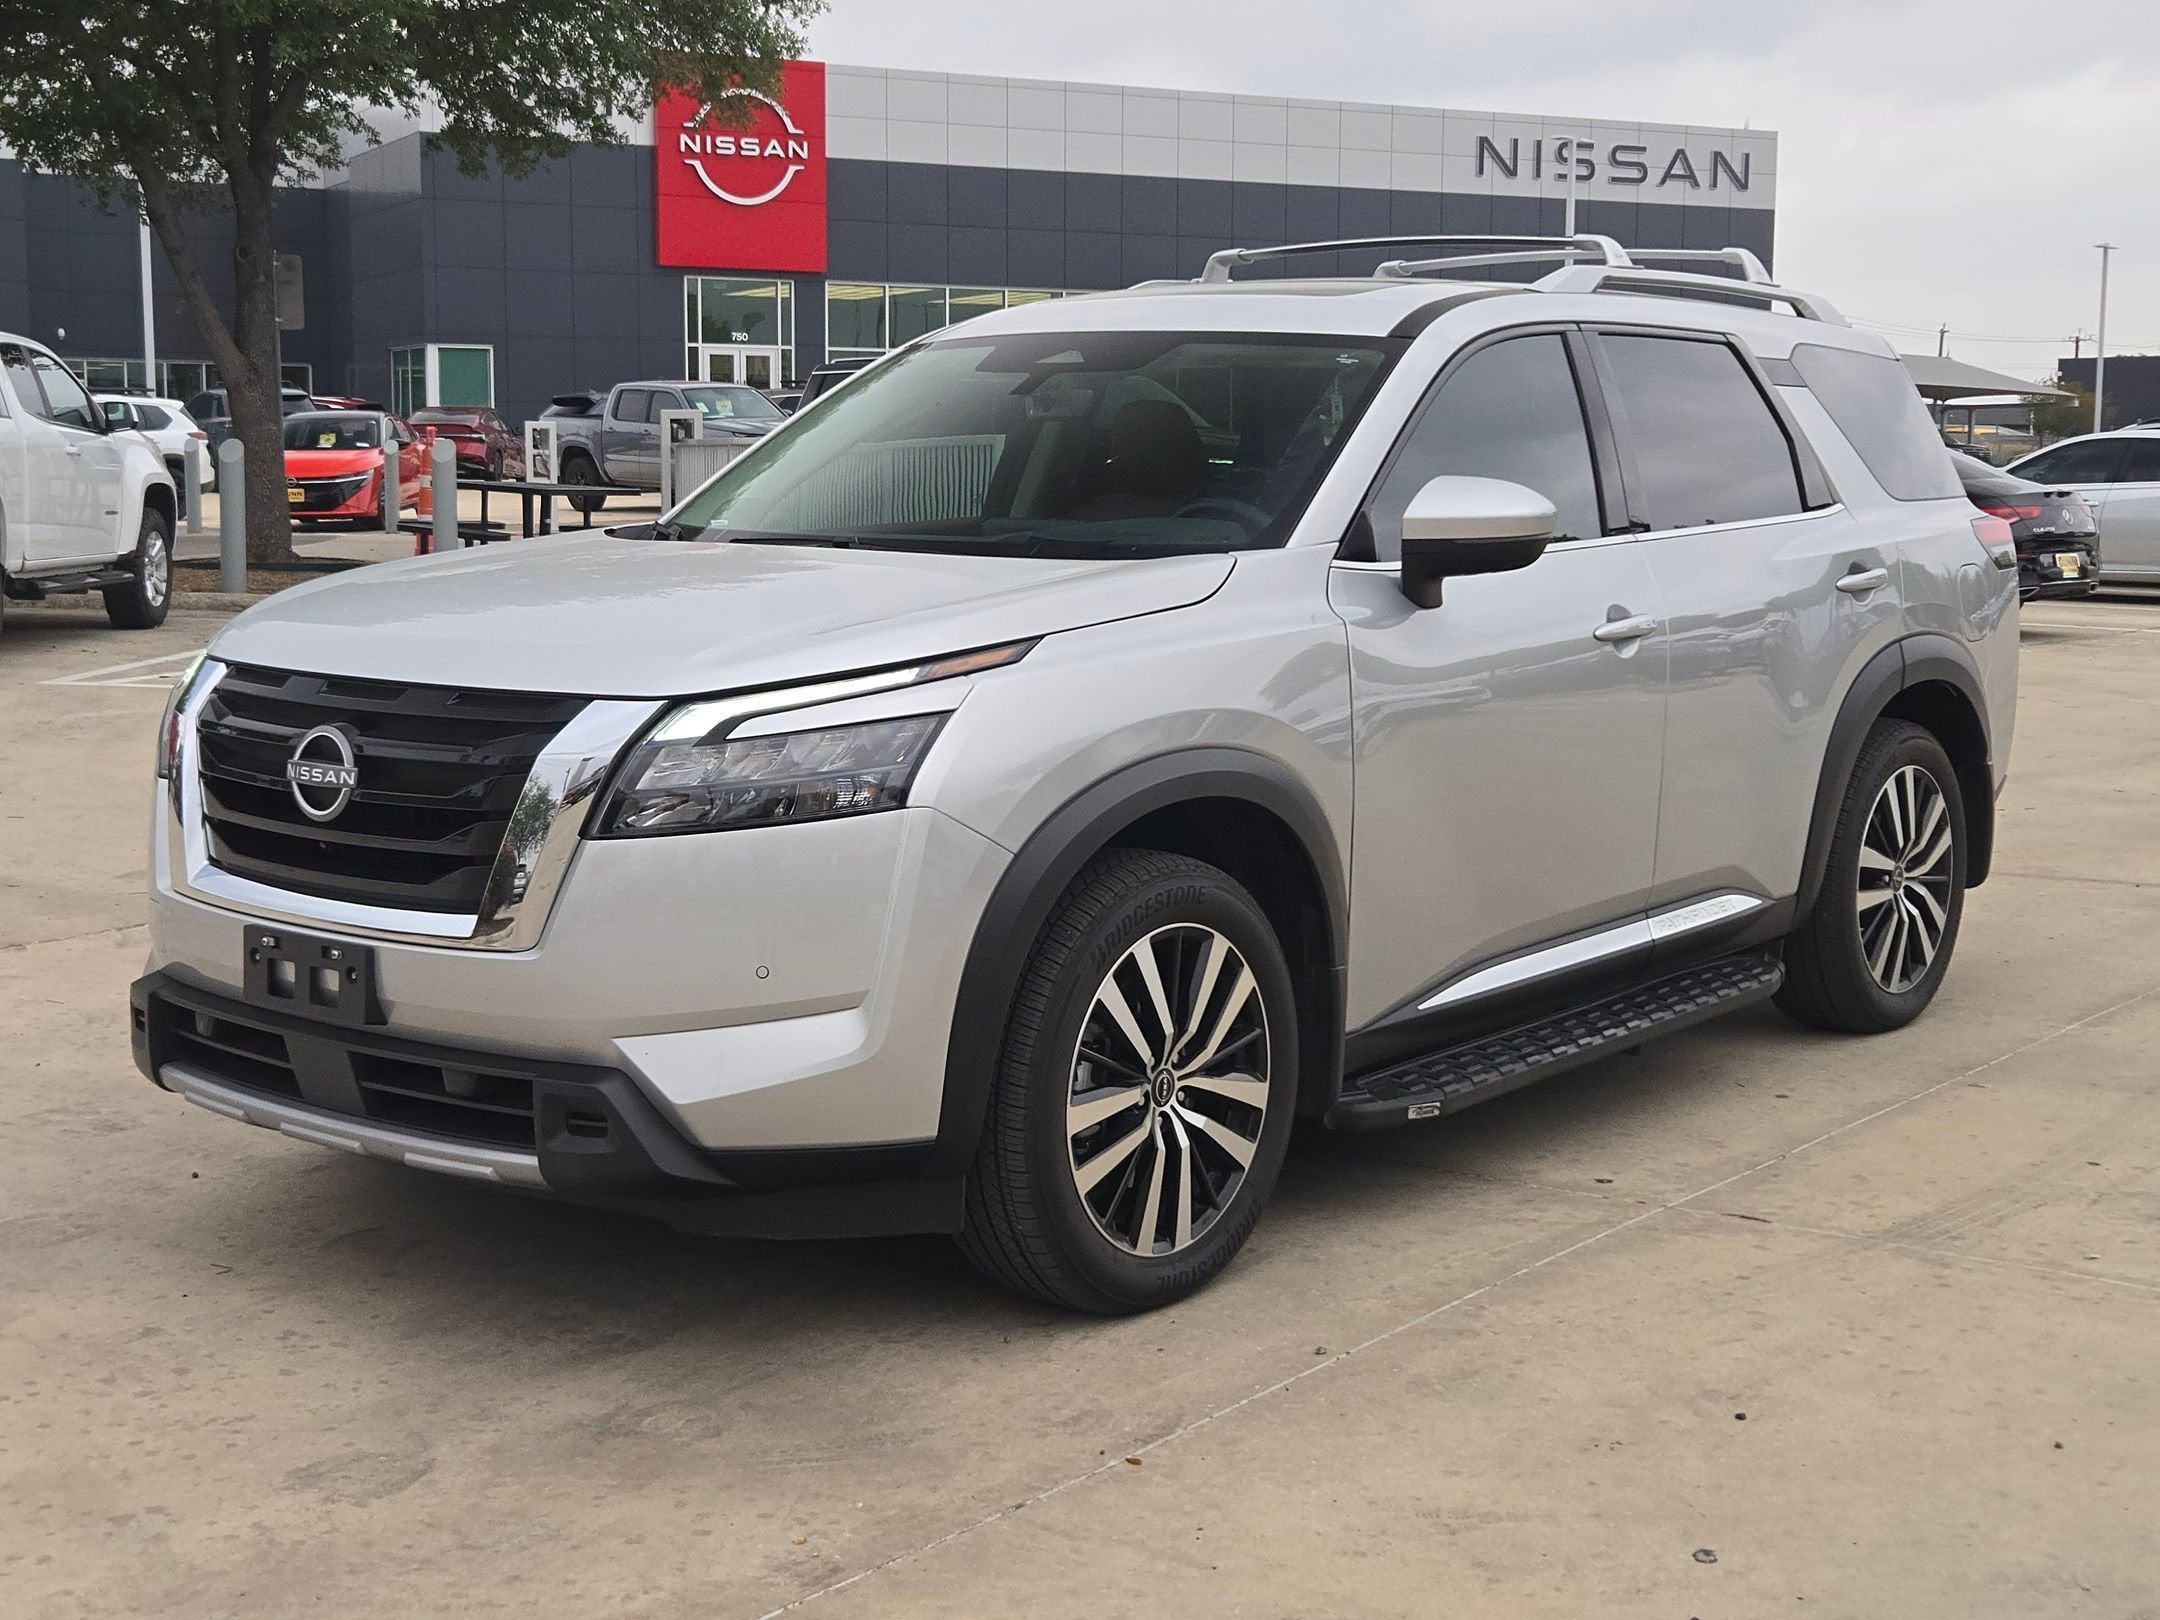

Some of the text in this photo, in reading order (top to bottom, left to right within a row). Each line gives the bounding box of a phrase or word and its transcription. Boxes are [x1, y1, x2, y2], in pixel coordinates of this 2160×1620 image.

[680, 134, 808, 159] NISSAN
[1476, 135, 1750, 191] NISSAN
[731, 332, 748, 341] 750
[287, 763, 355, 785] NISSAN
[1091, 885, 1207, 975] BRIDGESTONE
